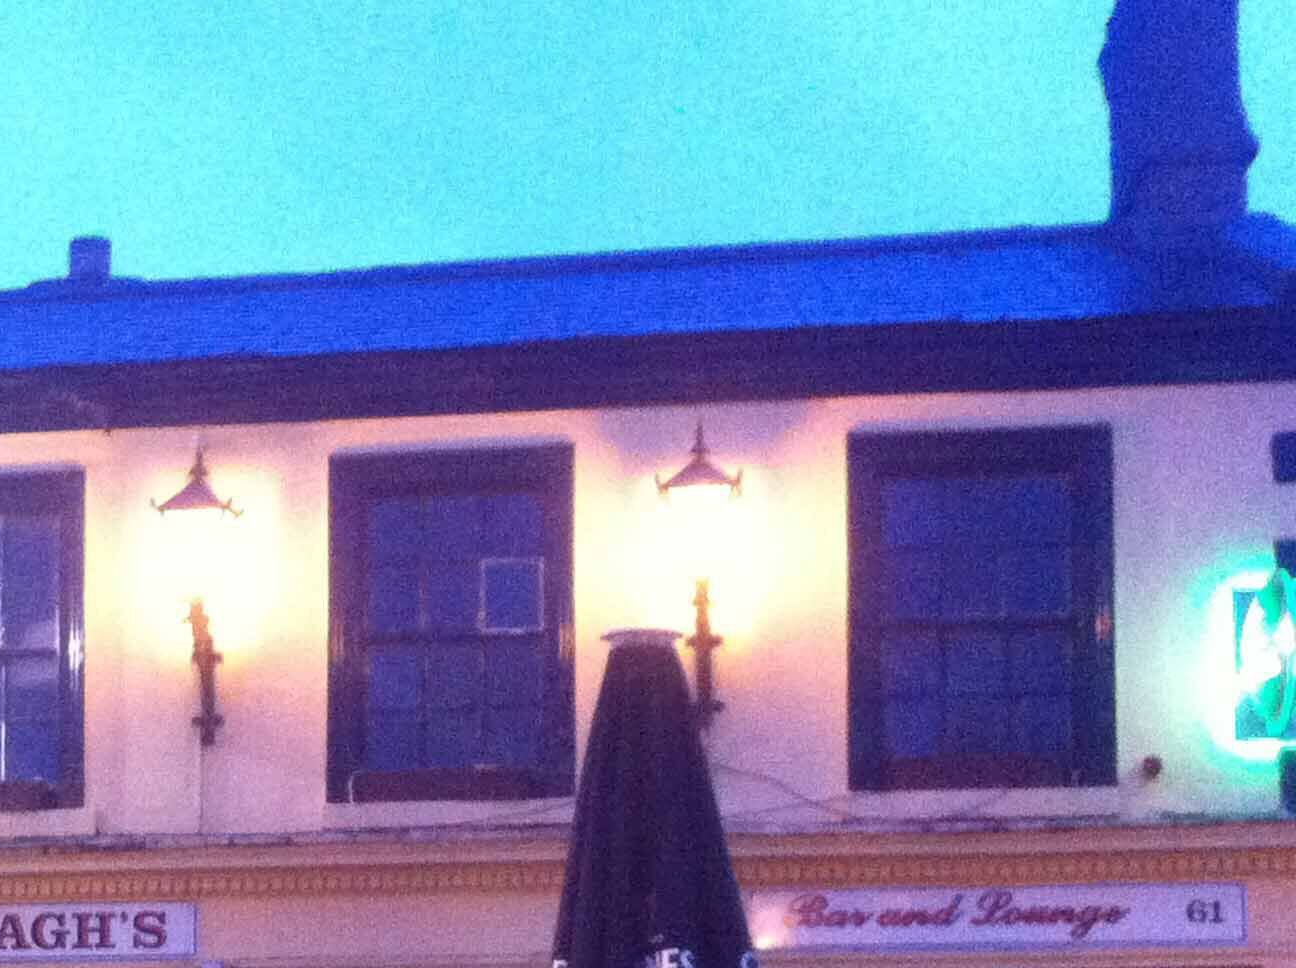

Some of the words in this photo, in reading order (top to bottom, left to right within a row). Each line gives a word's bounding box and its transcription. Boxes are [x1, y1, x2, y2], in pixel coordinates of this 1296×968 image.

[788, 893, 874, 929] Bar
[876, 894, 962, 928] and
[969, 888, 1131, 939] Lounge
[1185, 899, 1224, 926] 61
